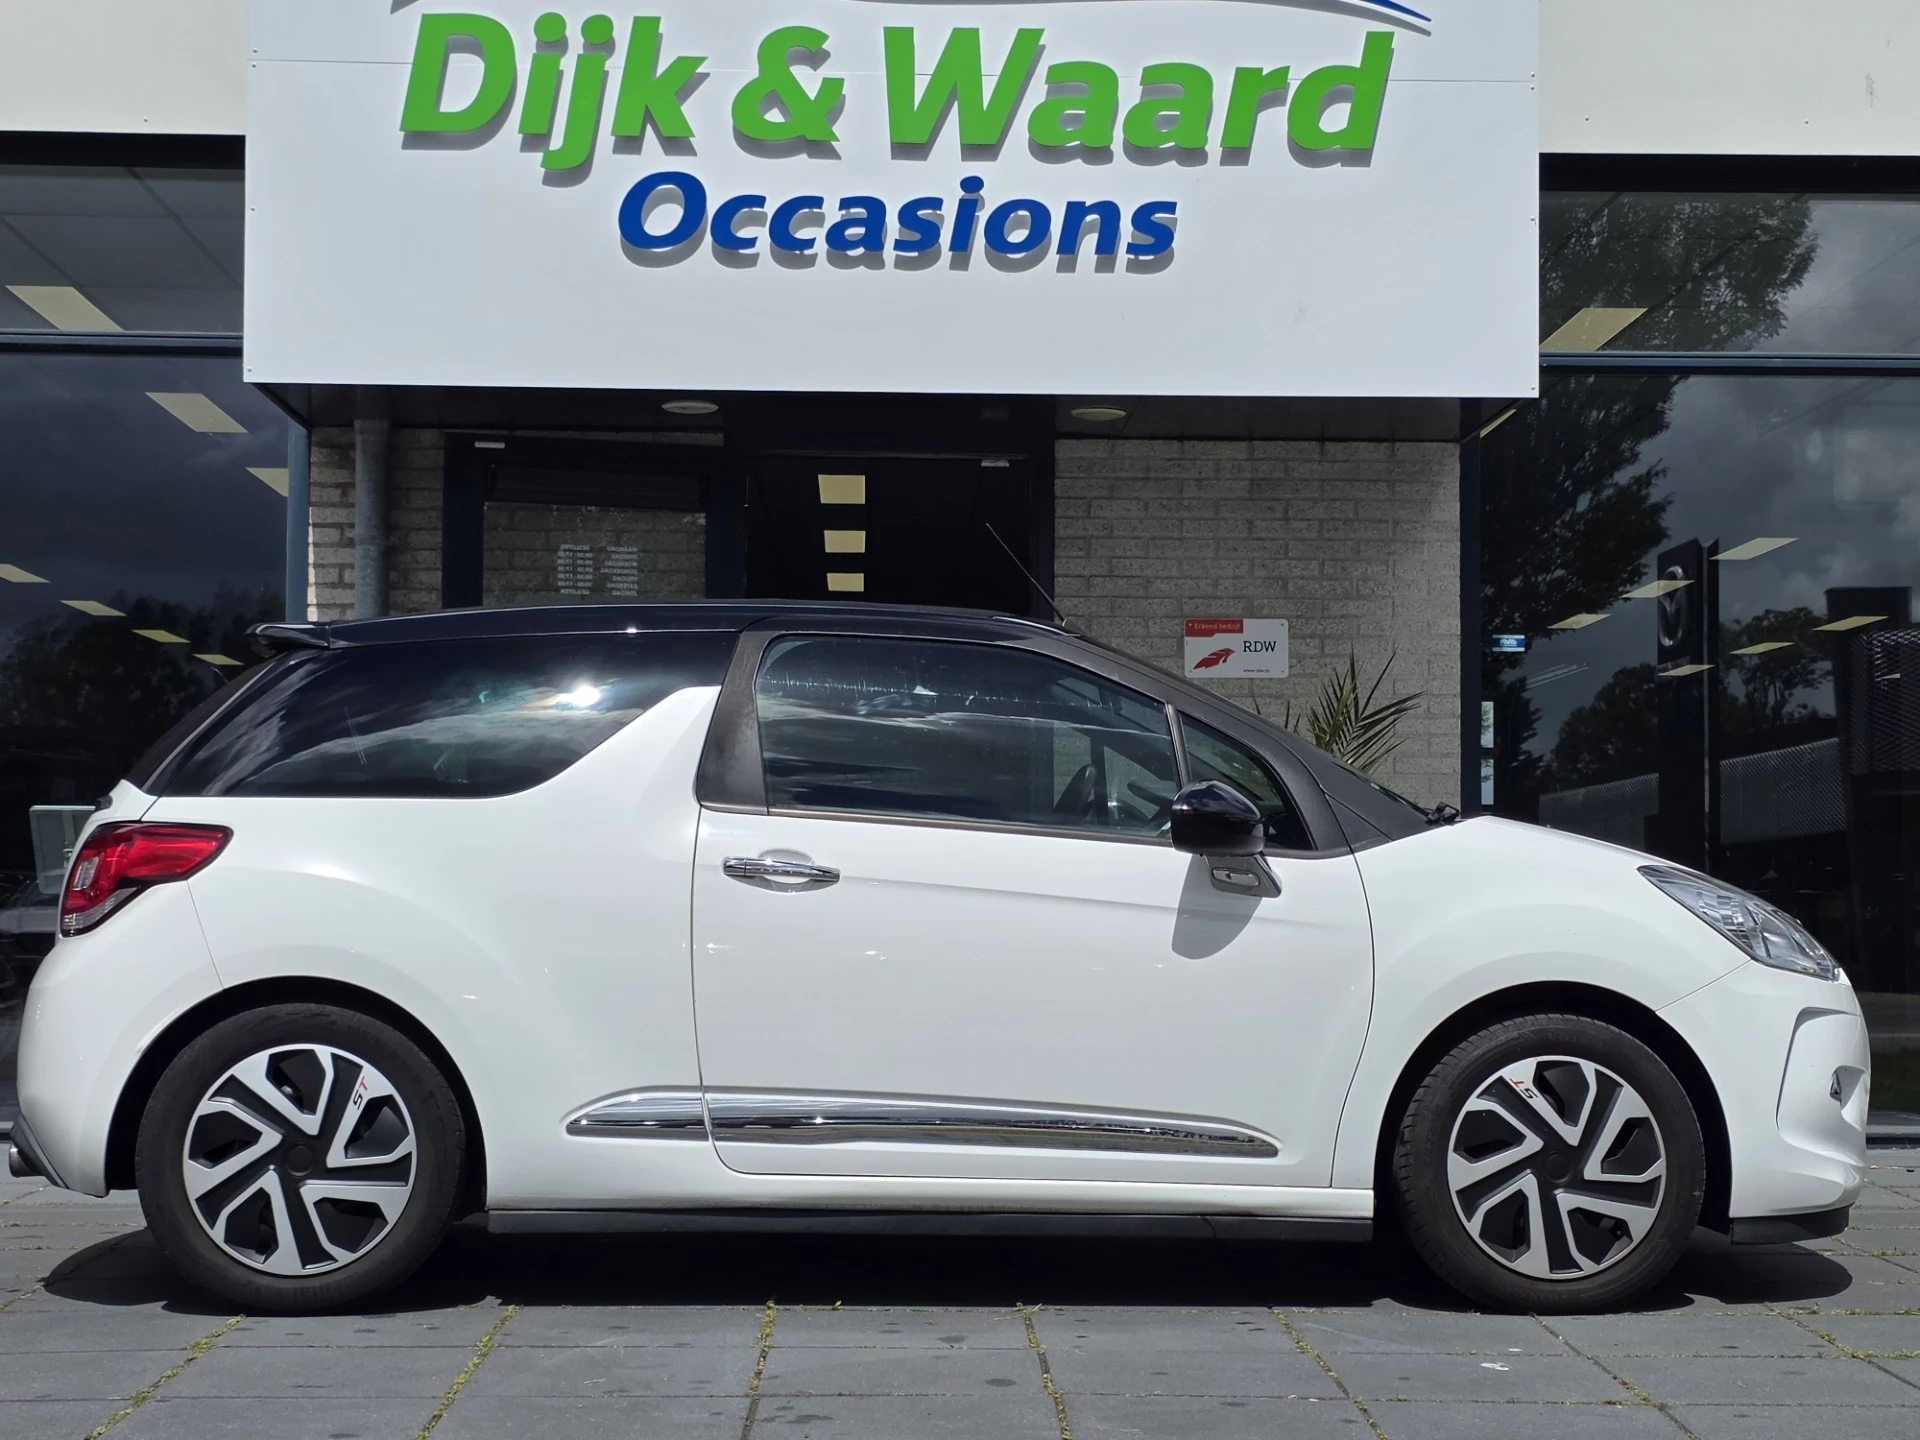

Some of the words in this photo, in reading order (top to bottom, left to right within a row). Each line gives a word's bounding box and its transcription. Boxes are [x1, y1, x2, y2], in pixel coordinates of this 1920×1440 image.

[400, 12, 708, 170] Dijk
[731, 26, 845, 142] &
[883, 27, 1394, 150] Waard
[618, 171, 1177, 256] Occasions
[1194, 622, 1218, 630] Erkend
[1218, 622, 1241, 631] bedrijf
[1243, 641, 1276, 653] RDW
[353, 1076, 368, 1110] ST
[1509, 1077, 1538, 1099] ST
